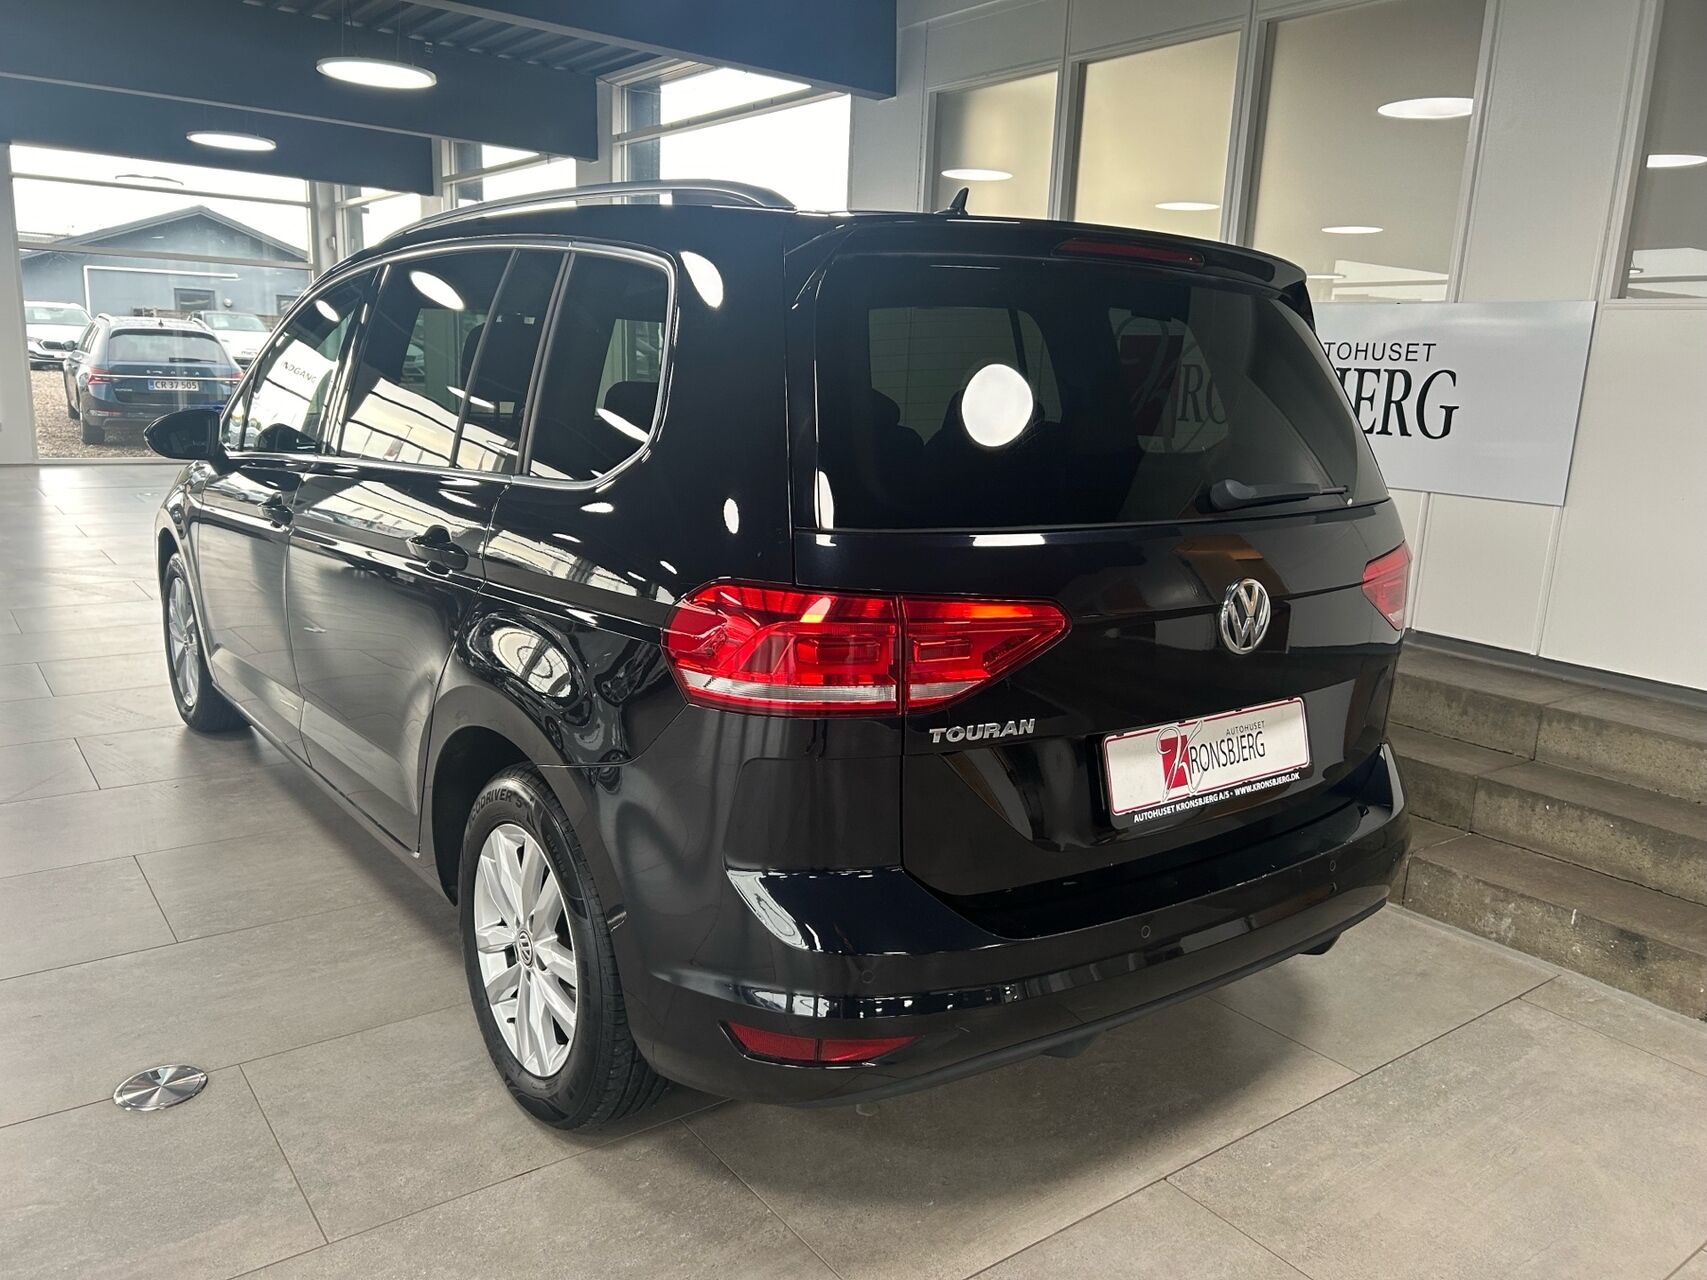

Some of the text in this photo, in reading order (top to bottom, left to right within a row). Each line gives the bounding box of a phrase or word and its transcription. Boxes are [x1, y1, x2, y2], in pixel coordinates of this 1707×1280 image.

[155, 381, 197, 390] CR 37 505
[929, 718, 1036, 744] TOURAN
[1226, 720, 1266, 736] AUTOHUSET
[469, 788, 512, 824] CODRIVER
[1133, 772, 1301, 823] AUTOHUSET KRONSBJERG A/S WWW.KRONSBJERG.DK
